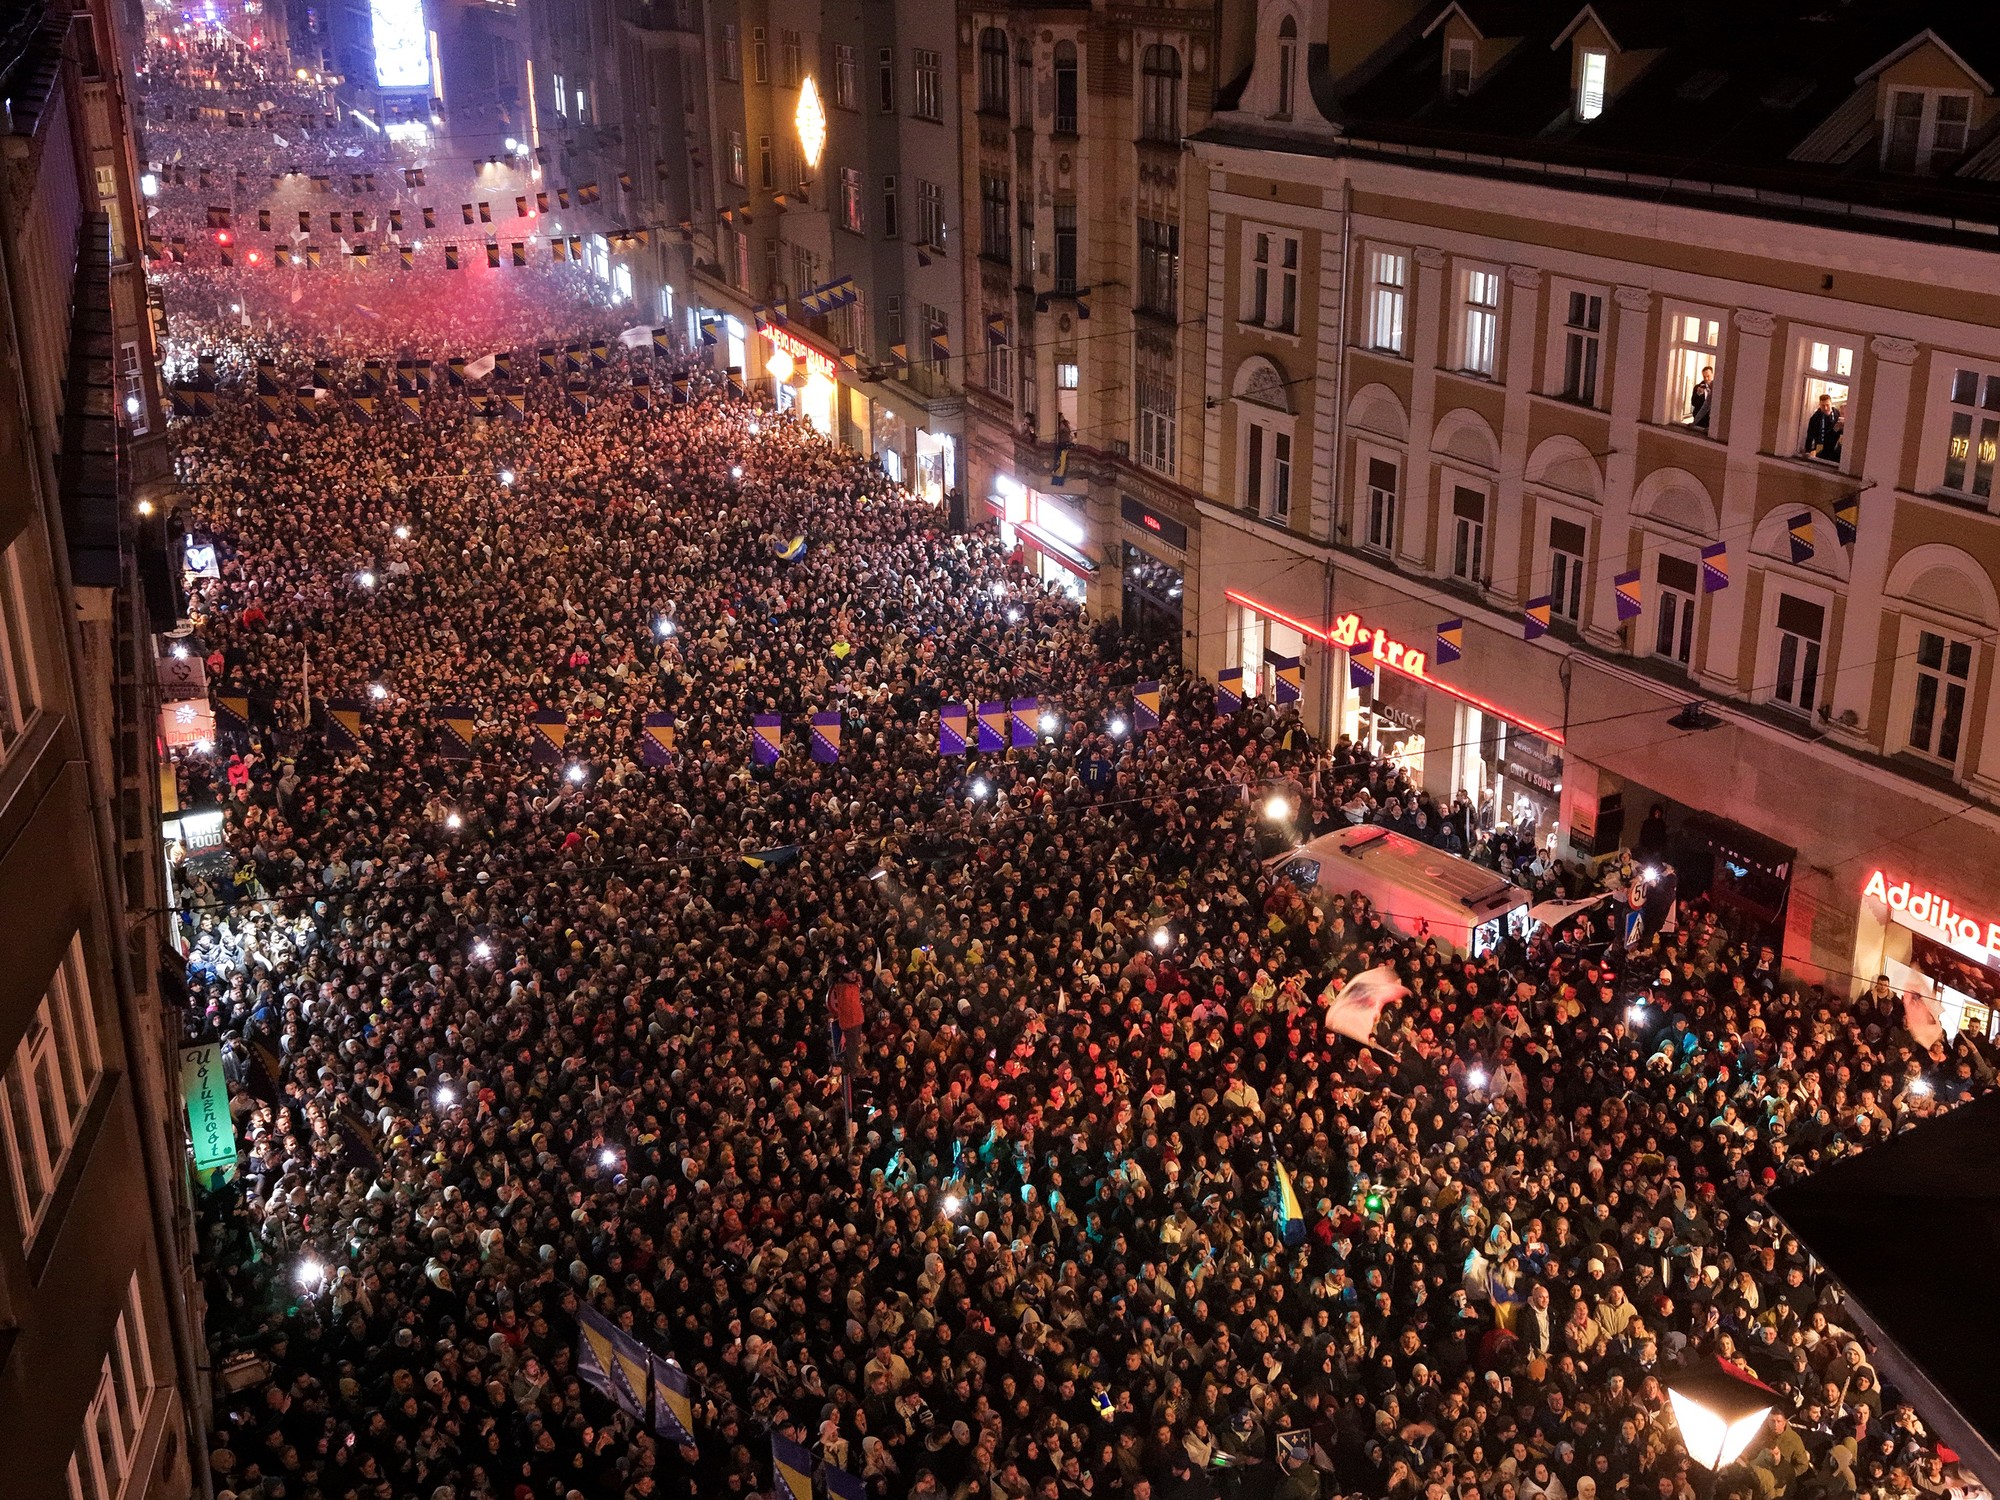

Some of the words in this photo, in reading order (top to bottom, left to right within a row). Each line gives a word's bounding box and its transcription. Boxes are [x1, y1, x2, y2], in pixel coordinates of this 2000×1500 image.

[1384, 706, 1421, 731] ONLY
[1513, 741, 1532, 755] VERO
[1090, 768, 1097, 780] 11
[1533, 774, 1552, 791] SONS
[189, 833, 221, 849] FOOD
[1634, 882, 1648, 902] 50
[1863, 870, 1981, 944] Addiko
